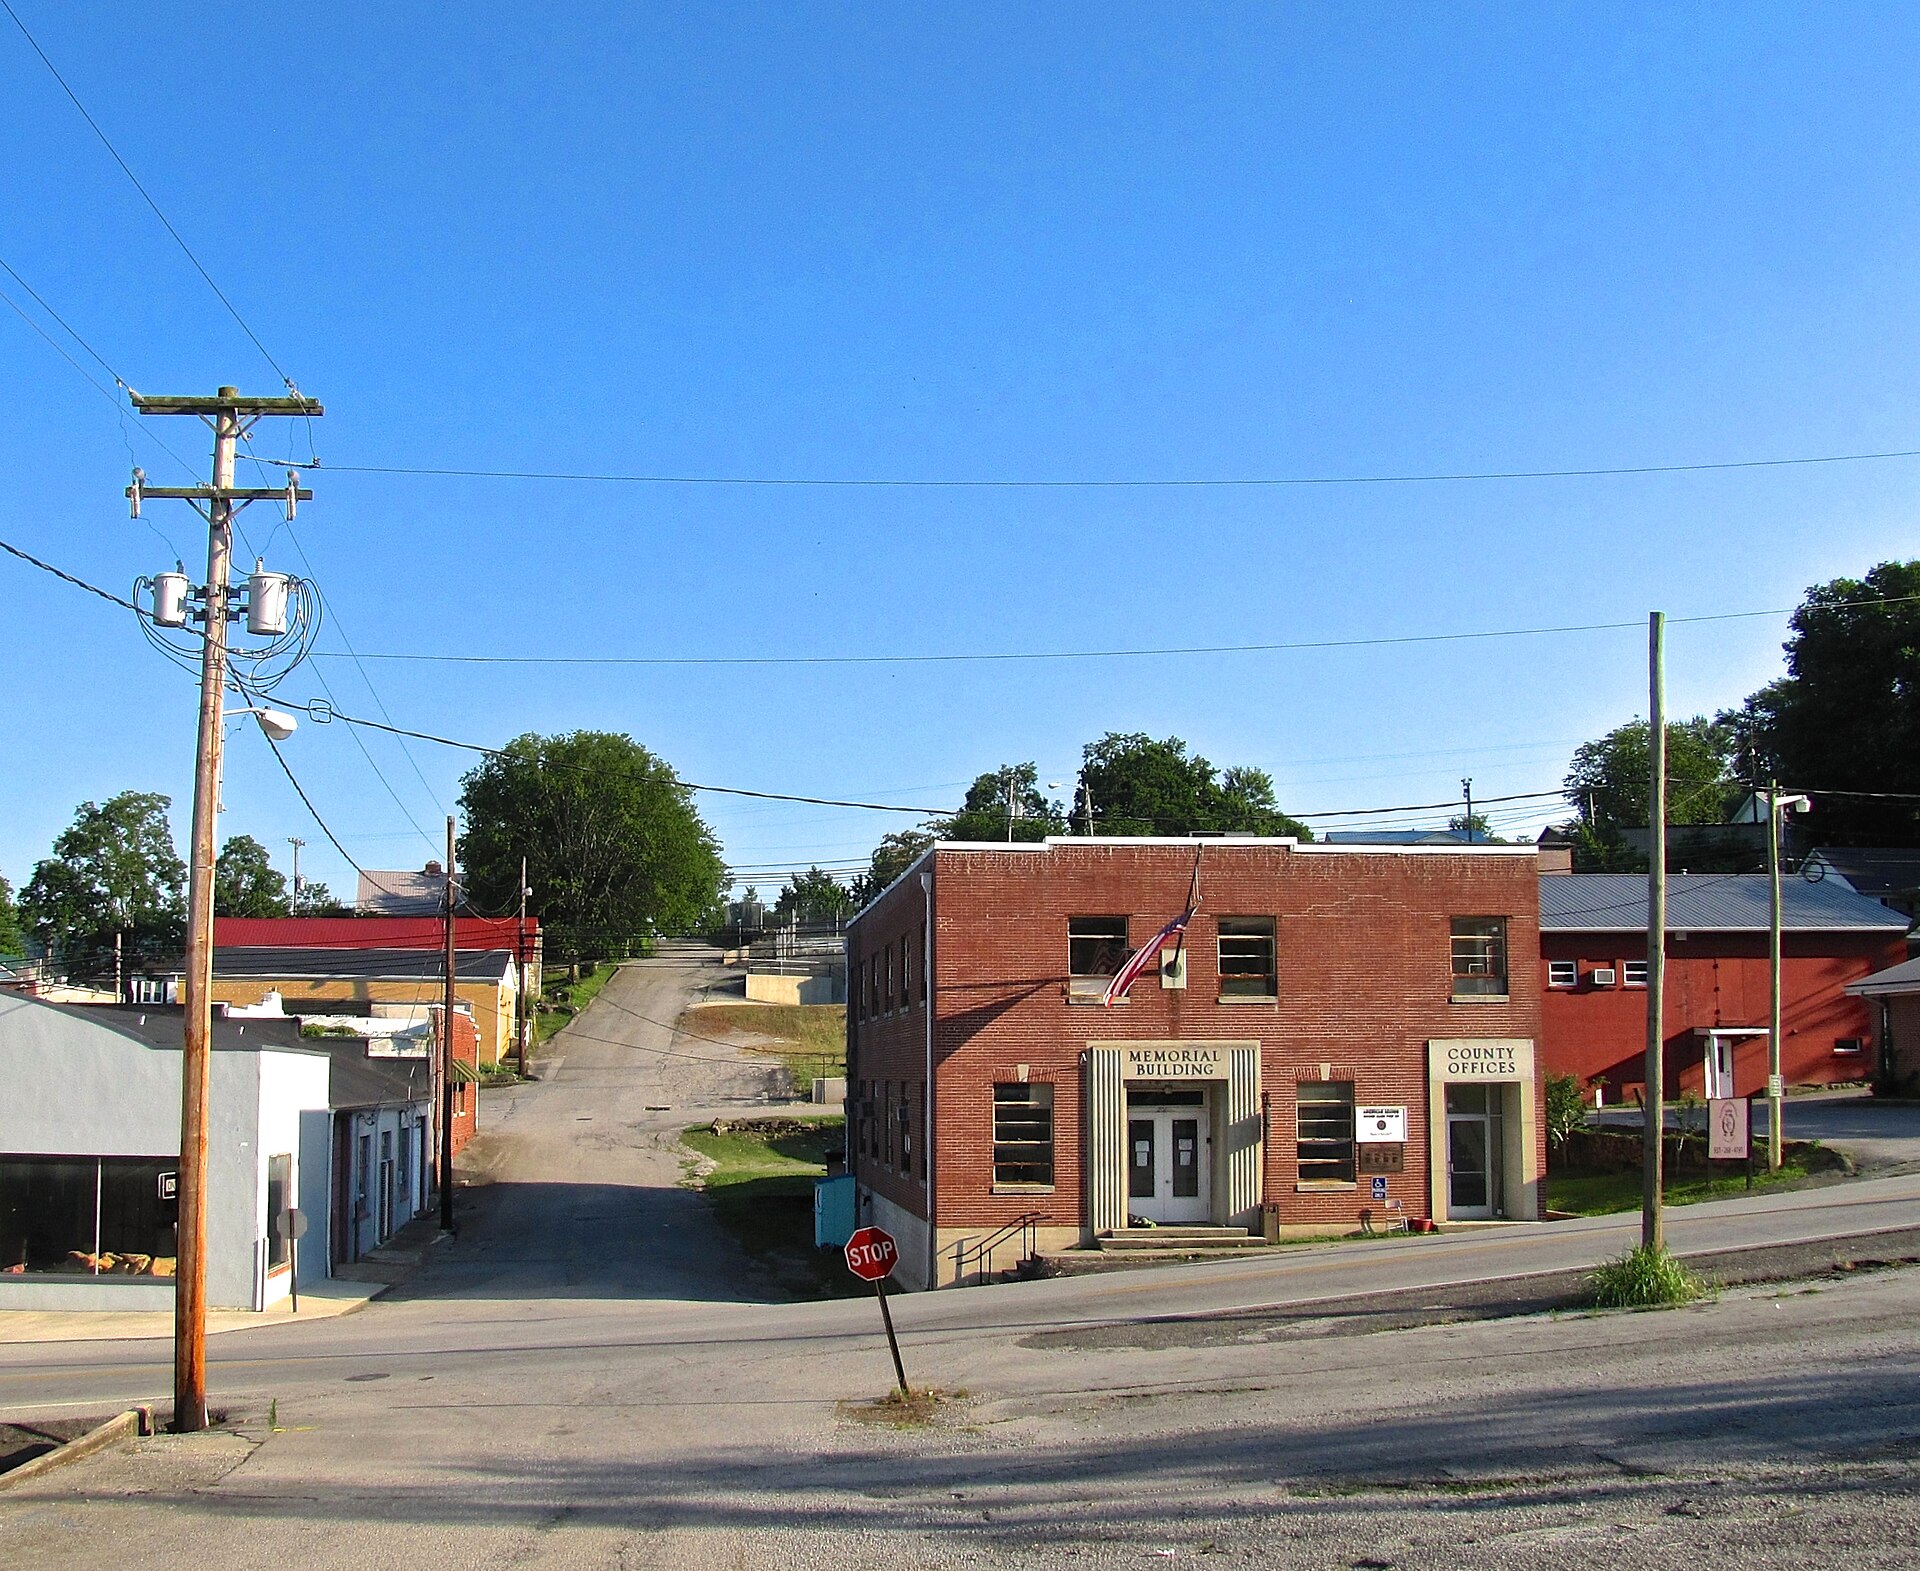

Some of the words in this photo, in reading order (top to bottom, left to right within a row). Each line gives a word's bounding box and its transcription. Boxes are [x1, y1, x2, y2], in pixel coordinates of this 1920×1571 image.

[1129, 1050, 1221, 1062] MEMORIAL
[1448, 1047, 1515, 1060] COUNTY
[1136, 1063, 1214, 1076] BUILDING
[1448, 1061, 1516, 1074] OFFICES
[849, 1241, 893, 1267] STOP
